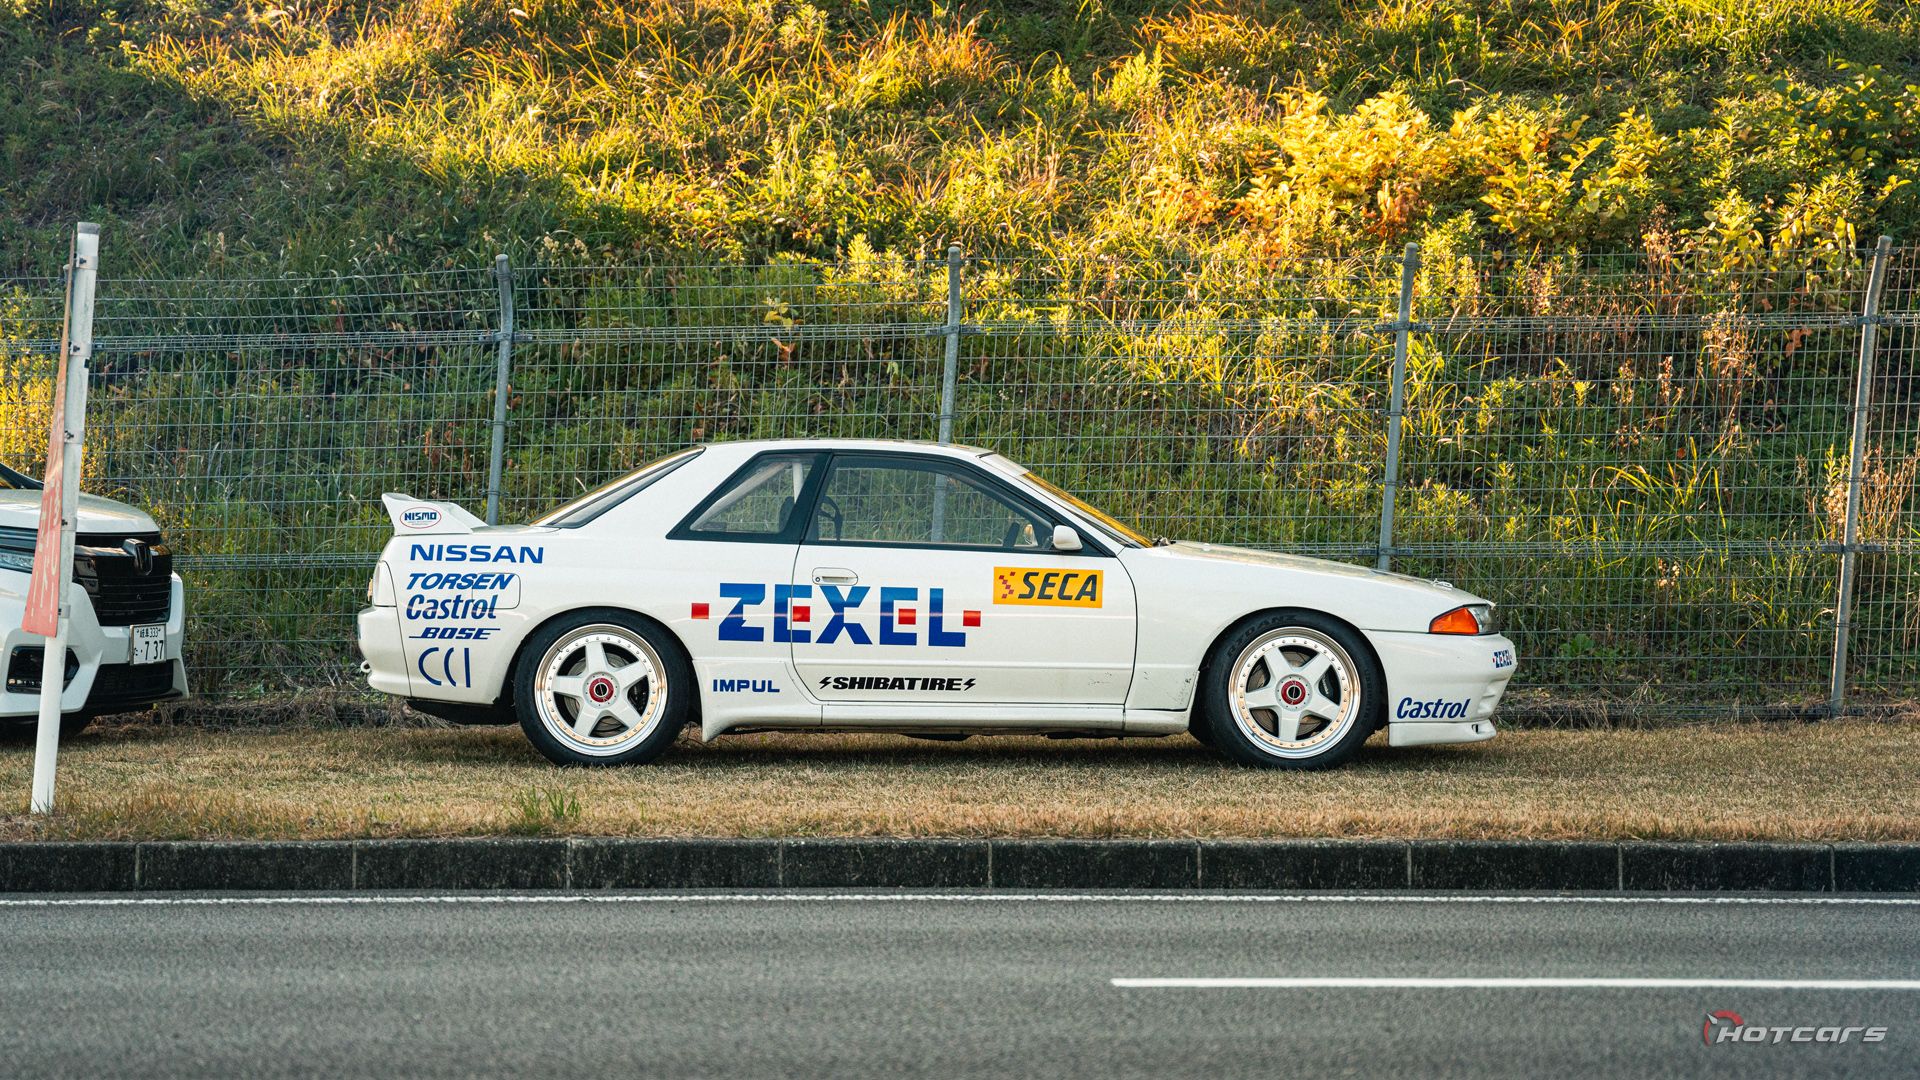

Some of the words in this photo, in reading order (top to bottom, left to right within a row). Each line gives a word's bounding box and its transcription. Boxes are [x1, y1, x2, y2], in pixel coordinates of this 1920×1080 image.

[404, 511, 437, 521] NISMO
[410, 544, 544, 564] NISSAN
[406, 573, 515, 590] TORSEN
[1018, 571, 1098, 602] SECA
[406, 594, 499, 620] Castrol
[718, 582, 966, 647] ZEXEL
[409, 627, 500, 640] BOSE
[418, 647, 471, 688] CCI
[713, 679, 780, 693] IMPUL
[832, 676, 964, 691] SHIBATIRE
[1396, 697, 1471, 719] Castrol
